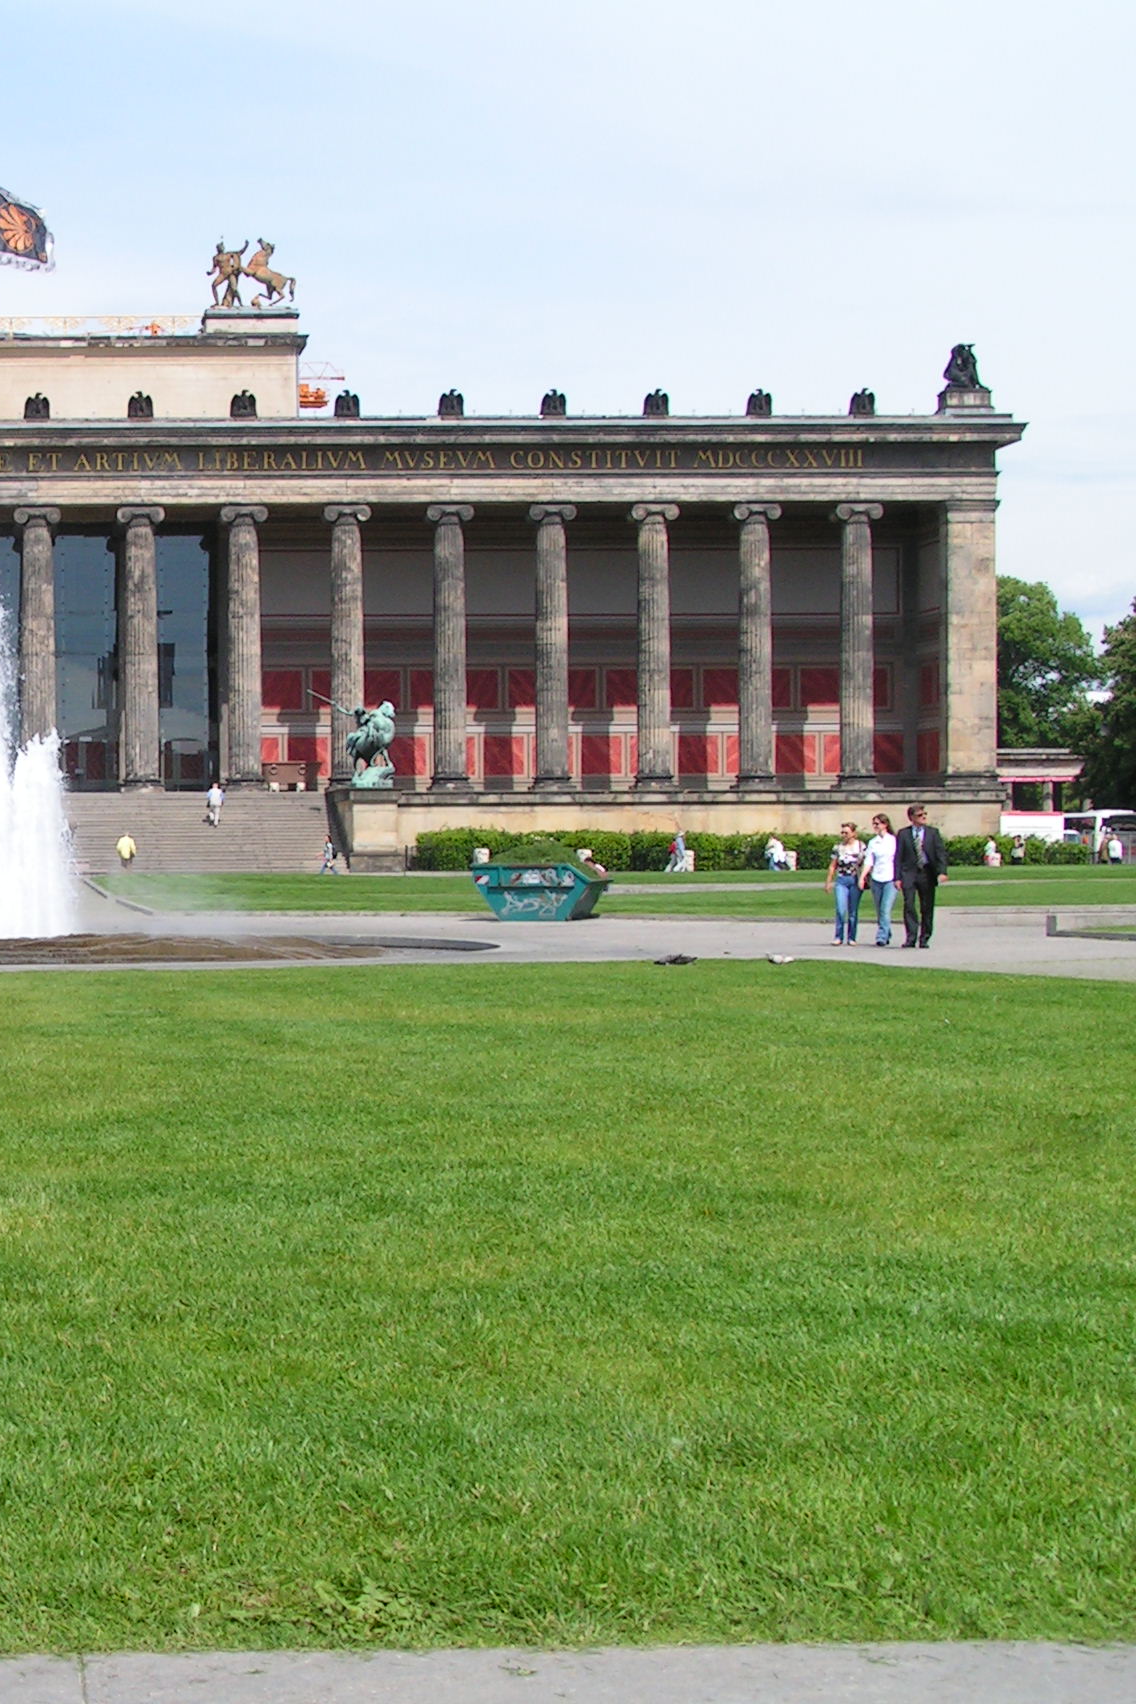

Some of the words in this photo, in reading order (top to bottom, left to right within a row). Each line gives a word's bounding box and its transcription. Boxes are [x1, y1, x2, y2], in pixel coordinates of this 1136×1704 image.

[27, 452, 64, 473] ET
[73, 451, 182, 473] ARTIVM
[197, 450, 366, 472] LIBERALIVM
[381, 450, 496, 471] MVSEVM
[509, 449, 681, 470] CONSTITVIT
[693, 449, 863, 469] MDCCCXXVIII
